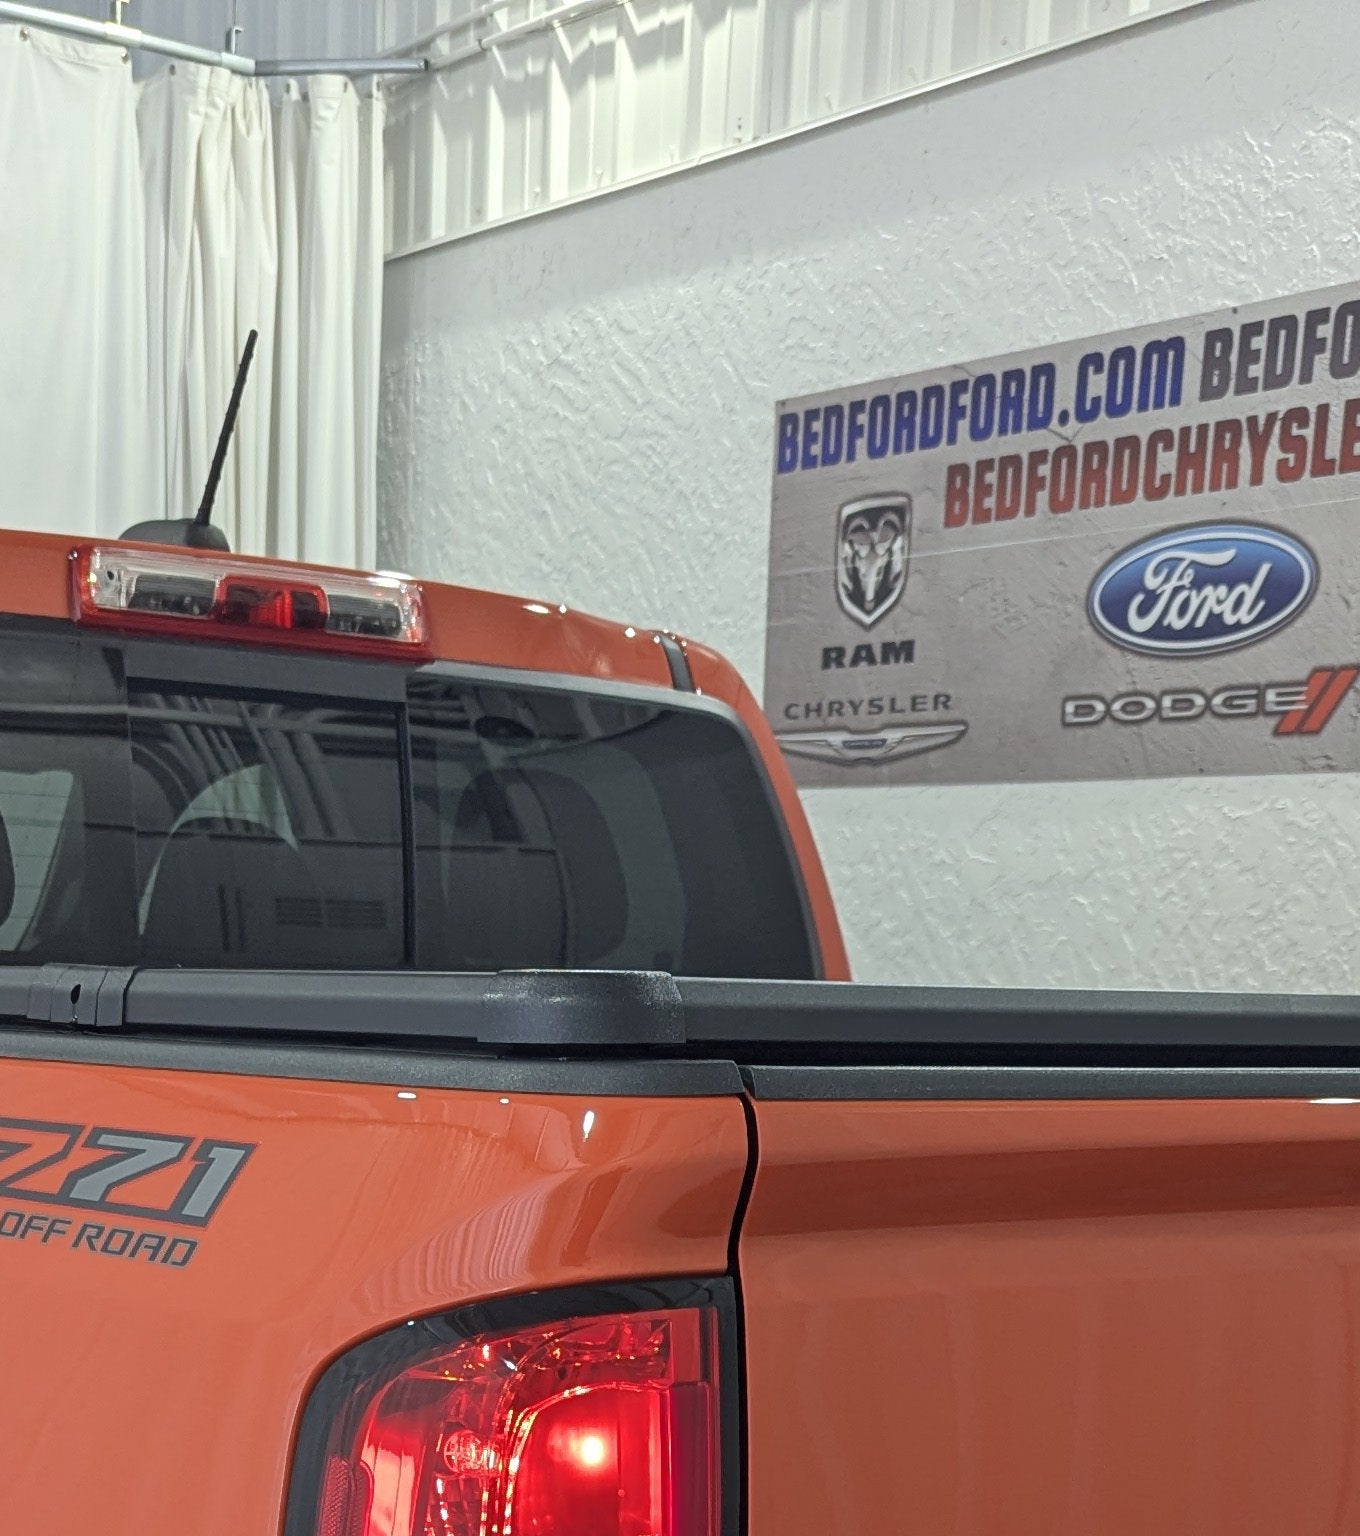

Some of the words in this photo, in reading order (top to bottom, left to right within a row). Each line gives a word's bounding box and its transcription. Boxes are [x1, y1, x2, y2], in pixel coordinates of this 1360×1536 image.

[776, 334, 1186, 475] BEDFORDFORD.COM
[1127, 548, 1273, 633] Ford
[821, 639, 915, 671] RAM
[783, 693, 953, 721] CHRYSLER
[1061, 682, 1308, 727] DODGE
[71, 1222, 199, 1269] ROAD
